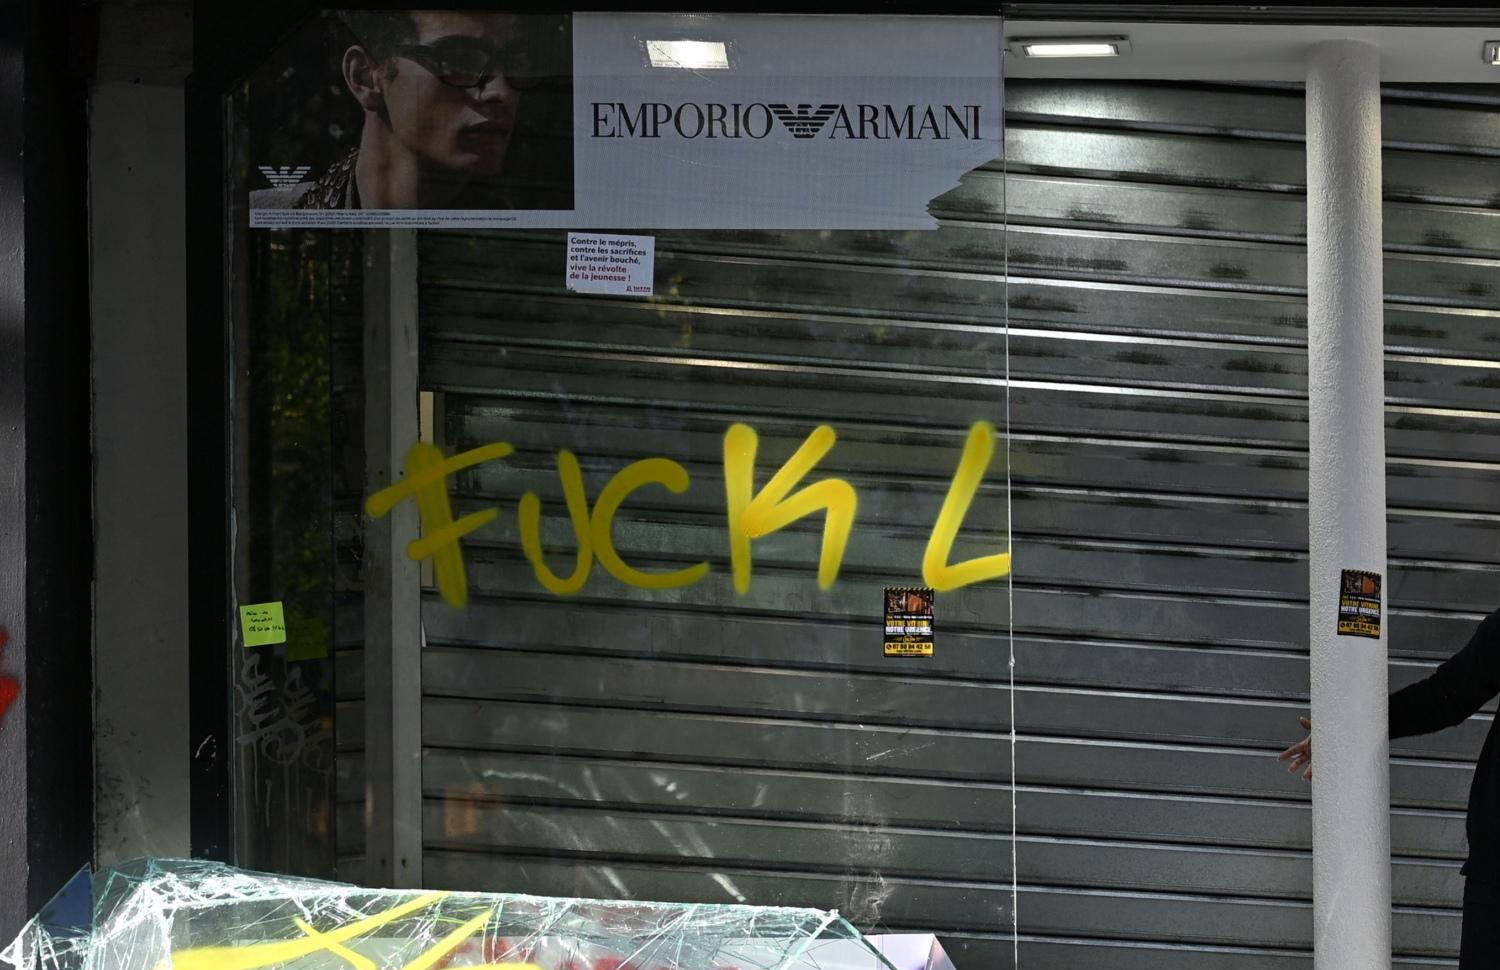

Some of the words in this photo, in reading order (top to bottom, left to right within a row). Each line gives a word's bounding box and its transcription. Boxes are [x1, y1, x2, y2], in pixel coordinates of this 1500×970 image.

[591, 102, 774, 139] EMPORIO
[828, 103, 982, 140] ARMANI
[570, 237, 597, 246] Contre
[599, 238, 606, 246] le
[608, 238, 637, 248] mépris,
[610, 248, 647, 256] sacrifices
[570, 254, 578, 262] et
[580, 254, 609, 263] l'avenir
[610, 255, 641, 265] bouché,
[570, 263, 587, 272] vive
[588, 263, 597, 272] la
[598, 264, 627, 273] révolte
[569, 271, 579, 280] de
[581, 272, 589, 280] la
[590, 273, 626, 282] jeunesse
[366, 421, 858, 610] FUCK
[921, 419, 1010, 592] L
